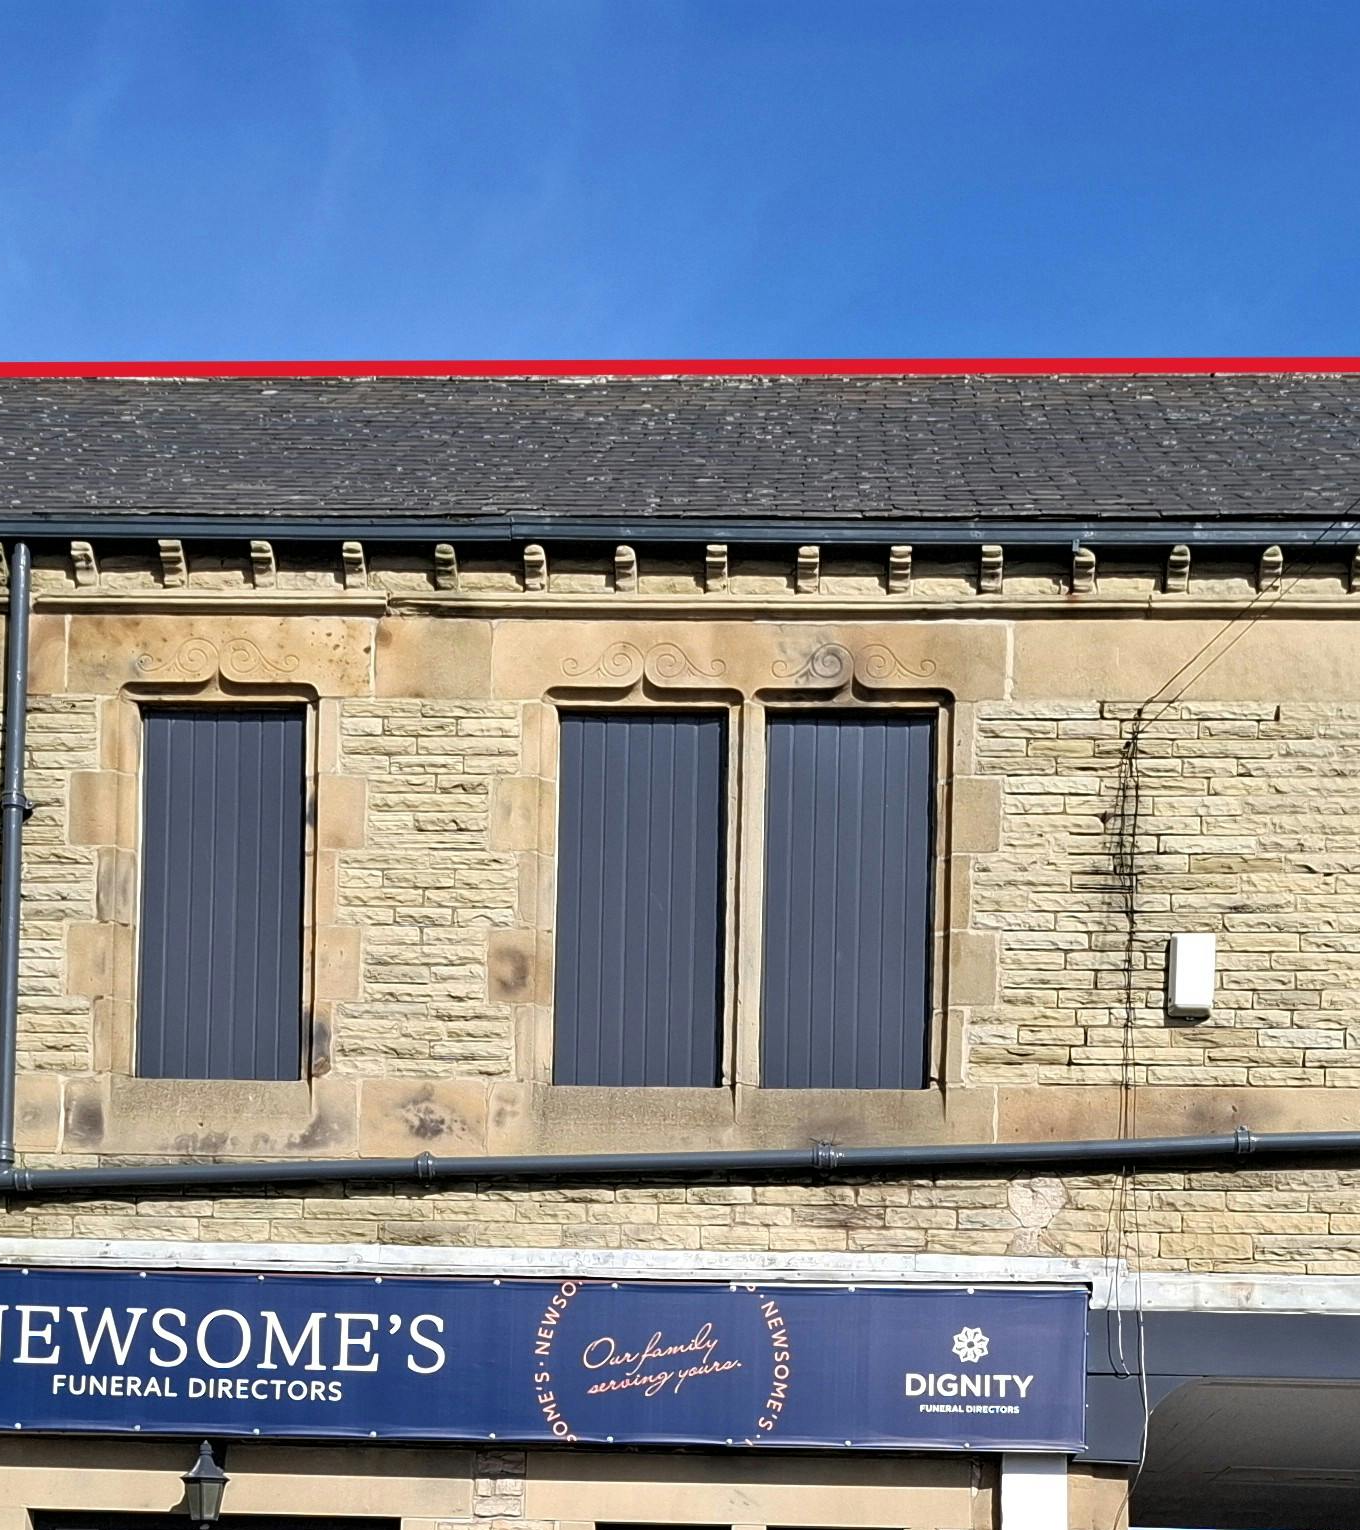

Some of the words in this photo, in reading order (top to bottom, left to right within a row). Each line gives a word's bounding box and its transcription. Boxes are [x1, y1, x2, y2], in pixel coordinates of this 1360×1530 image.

[582, 1336, 640, 1369] Our
[625, 1322, 718, 1377] family
[758, 1300, 790, 1431] NEWSOME'S
[52, 1374, 178, 1398] FUNERAL
[188, 1377, 342, 1402] DIRECTORS
[586, 1371, 676, 1397] serving
[674, 1359, 741, 1394] yours.
[905, 1373, 1034, 1398] DIGNITY
[919, 1404, 965, 1413] FUNERAL
[966, 1405, 1020, 1414] DIRECTORS
